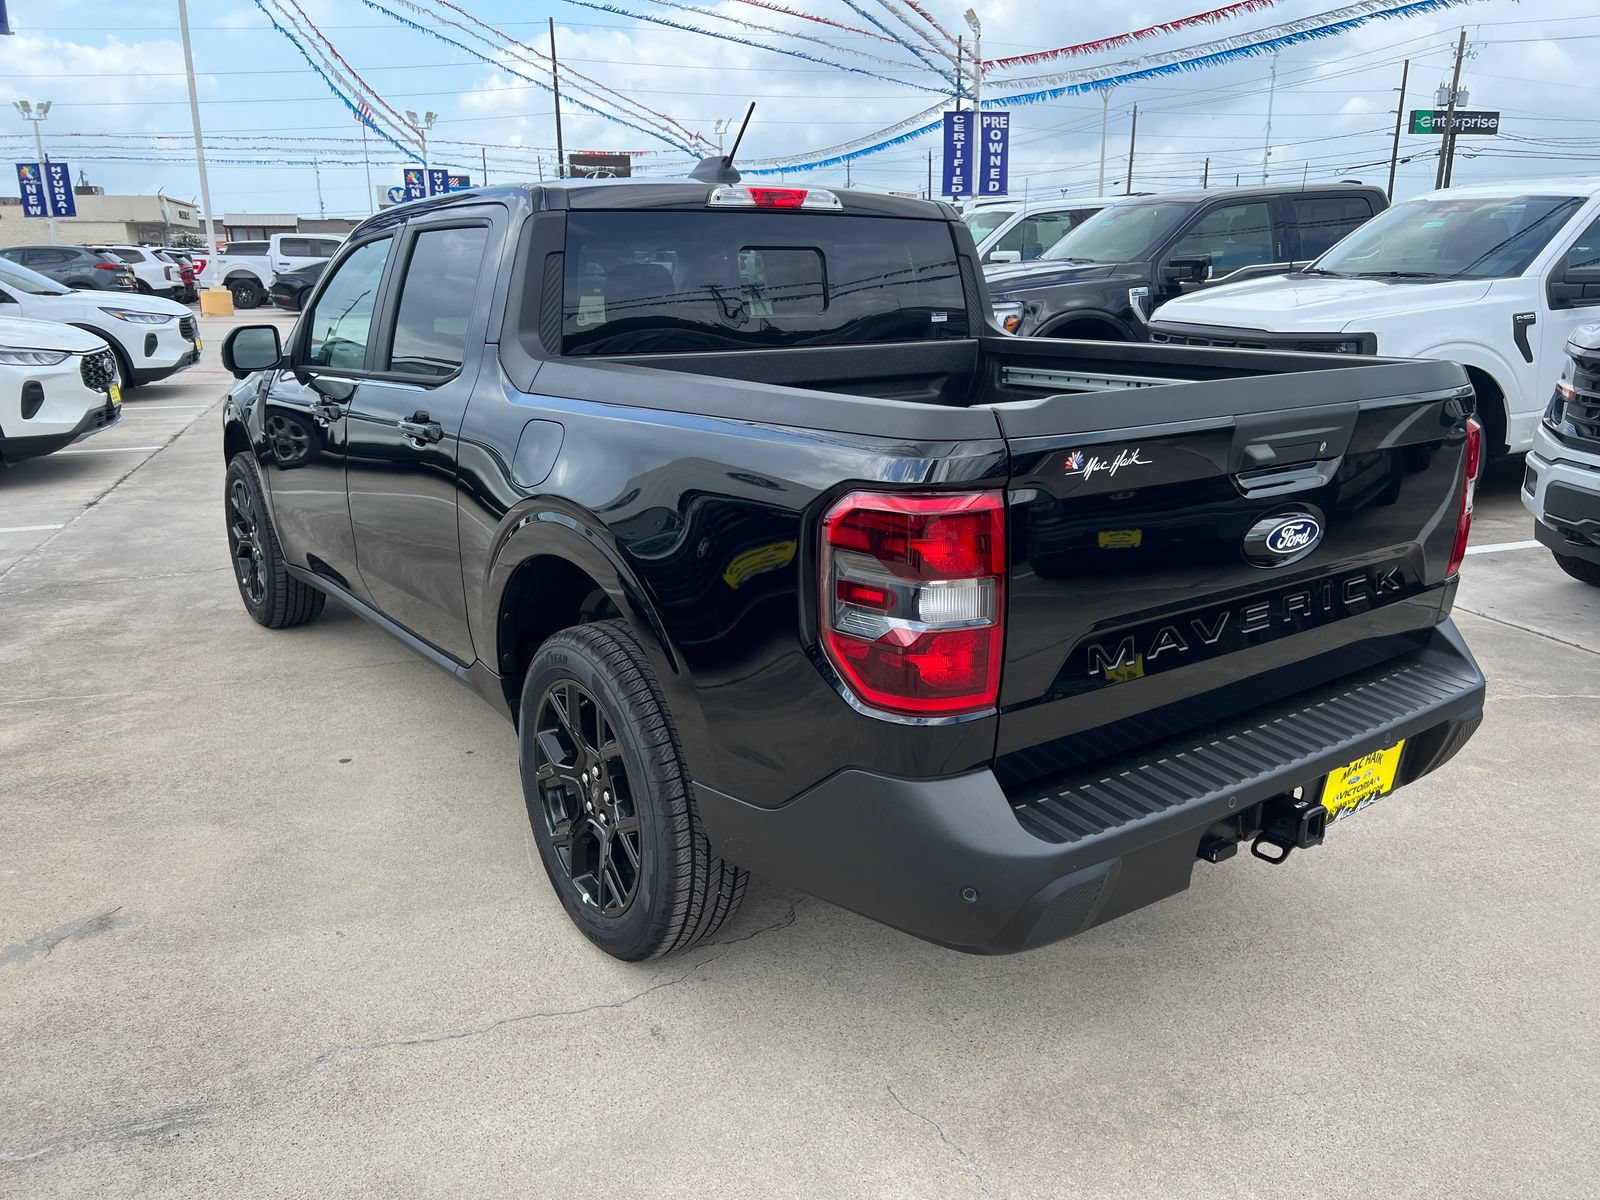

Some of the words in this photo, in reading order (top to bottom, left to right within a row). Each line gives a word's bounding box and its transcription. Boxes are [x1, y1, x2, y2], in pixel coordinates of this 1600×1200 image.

[982, 116, 1008, 129] PRE
[951, 115, 965, 193] CERTIFIED
[988, 129, 1003, 192] OWNED
[25, 184, 42, 215] NEW
[50, 166, 68, 214] HYUNDAI
[1065, 456, 1110, 481] Mac
[1277, 524, 1311, 549] Ford
[1088, 566, 1400, 675] MAVERICK
